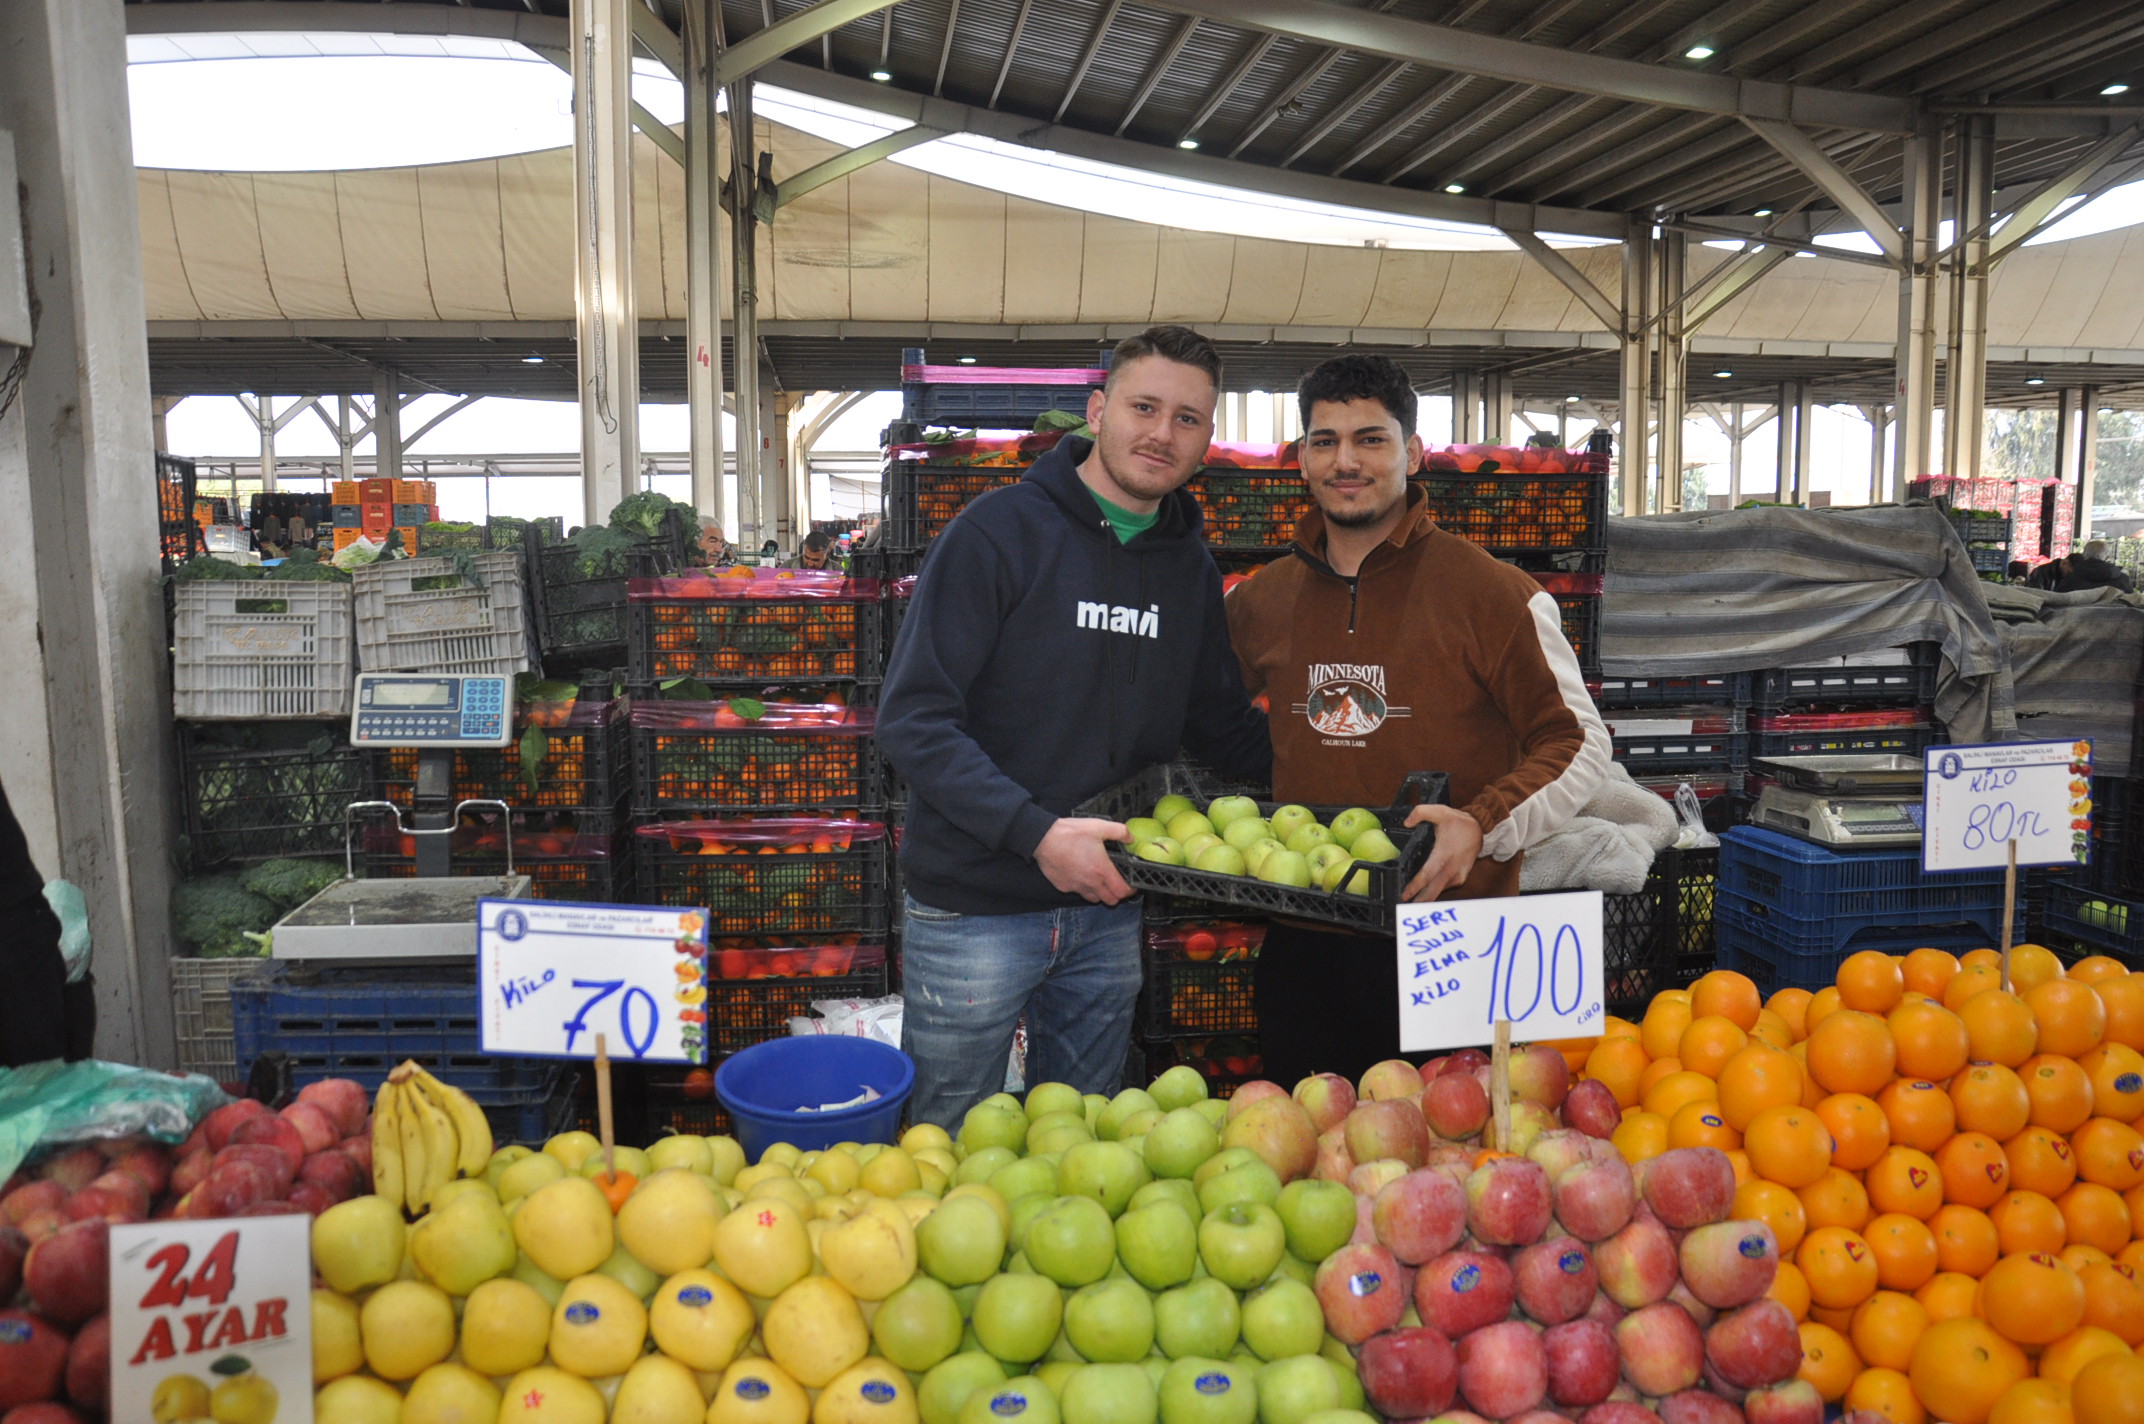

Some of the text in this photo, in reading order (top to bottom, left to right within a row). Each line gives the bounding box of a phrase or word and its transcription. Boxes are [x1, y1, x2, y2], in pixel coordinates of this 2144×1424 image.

[697, 345, 709, 367] 4
[779, 458, 784, 468] 7
[1077, 600, 1159, 639] mavi
[1307, 663, 1387, 696] MINNESOTA
[1321, 739, 1350, 747] CALHOUN
[1402, 908, 1458, 936] SERT
[1407, 929, 1464, 955] SULU
[1413, 950, 1470, 979] ELMA
[1478, 915, 1583, 1025] 100
[563, 978, 659, 1059] 70
[138, 1229, 240, 1309] 24
[129, 1296, 288, 1367] AYAR
